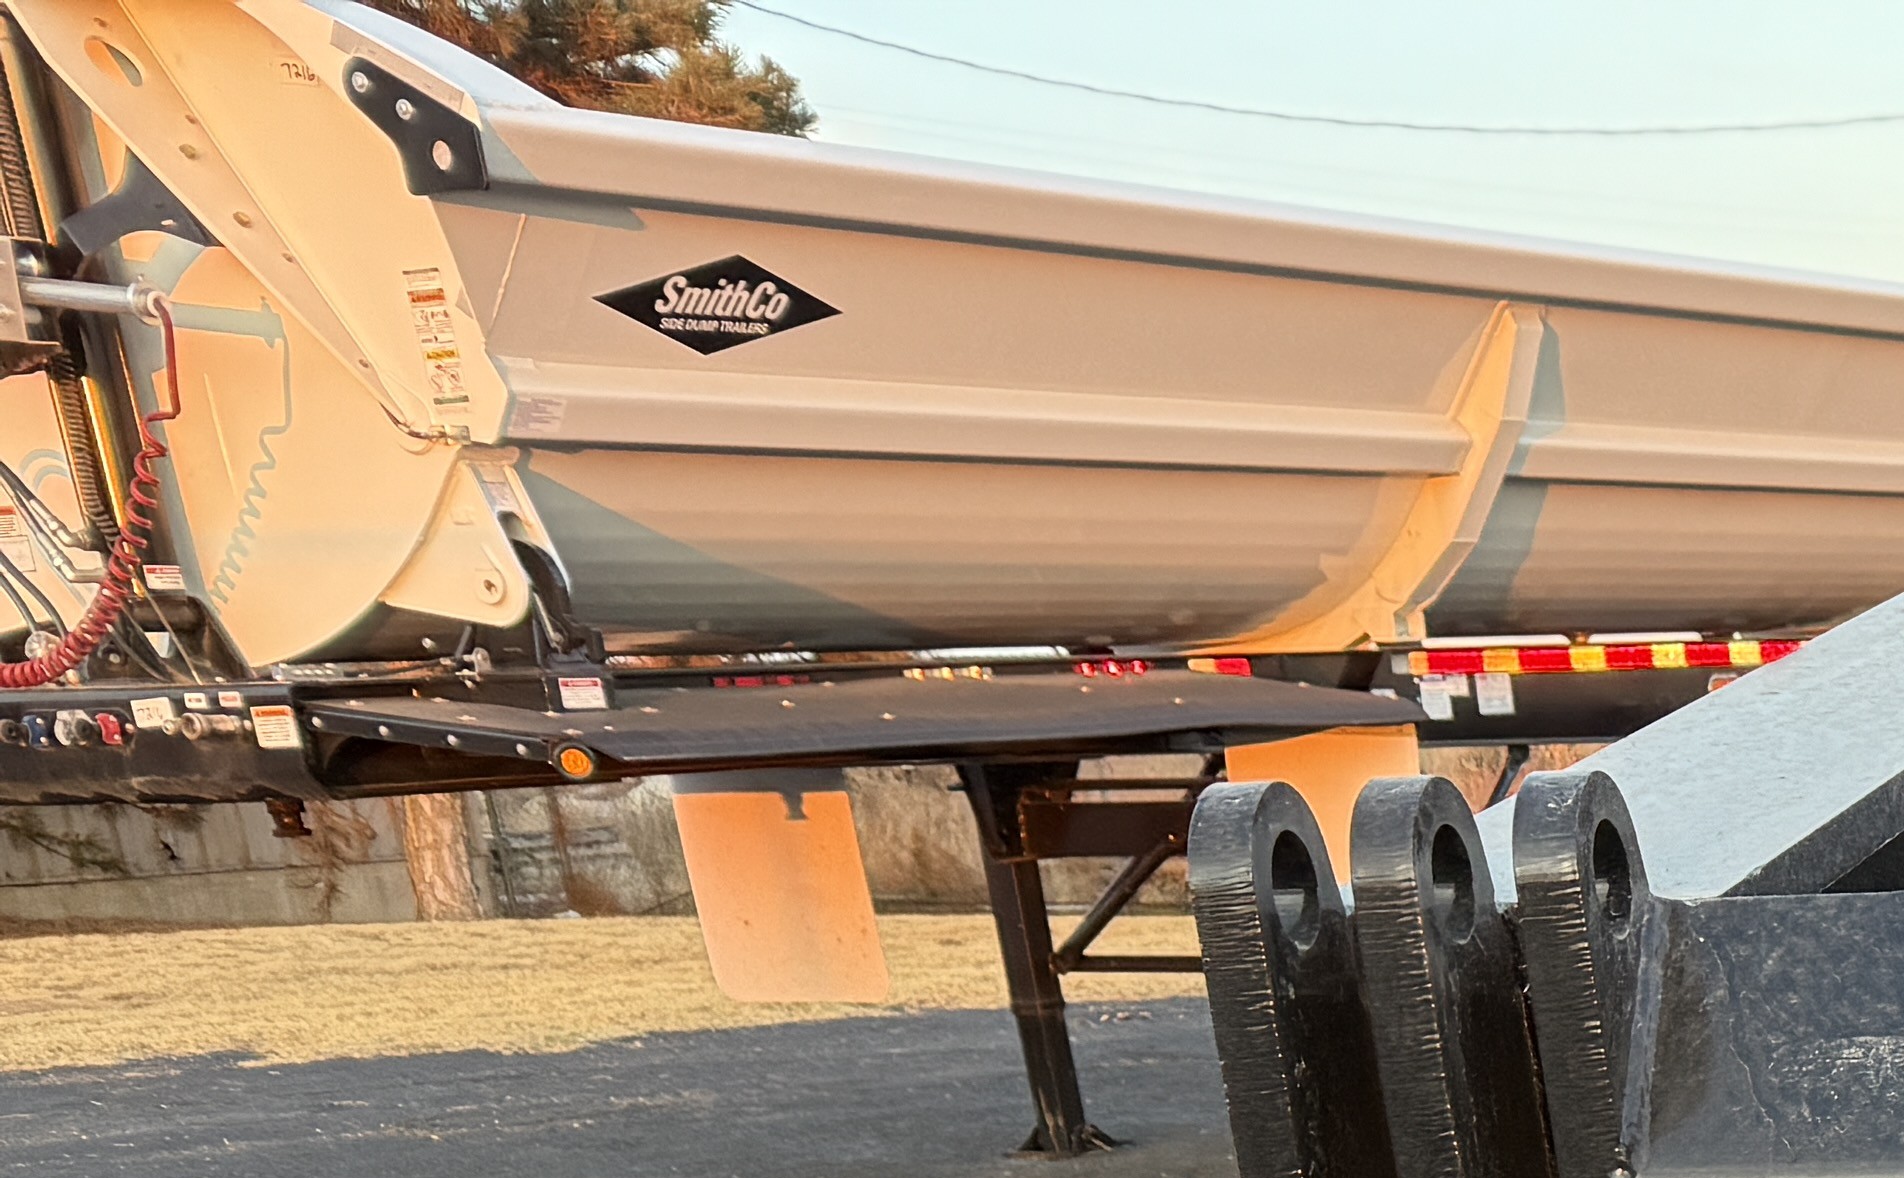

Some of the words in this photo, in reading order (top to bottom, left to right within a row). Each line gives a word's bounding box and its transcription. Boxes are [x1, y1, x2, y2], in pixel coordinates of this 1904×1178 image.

[654, 275, 790, 320] SmithCo
[659, 317, 684, 331] SIDE
[685, 318, 718, 332] DUMP
[720, 320, 770, 335] TRAILERS
